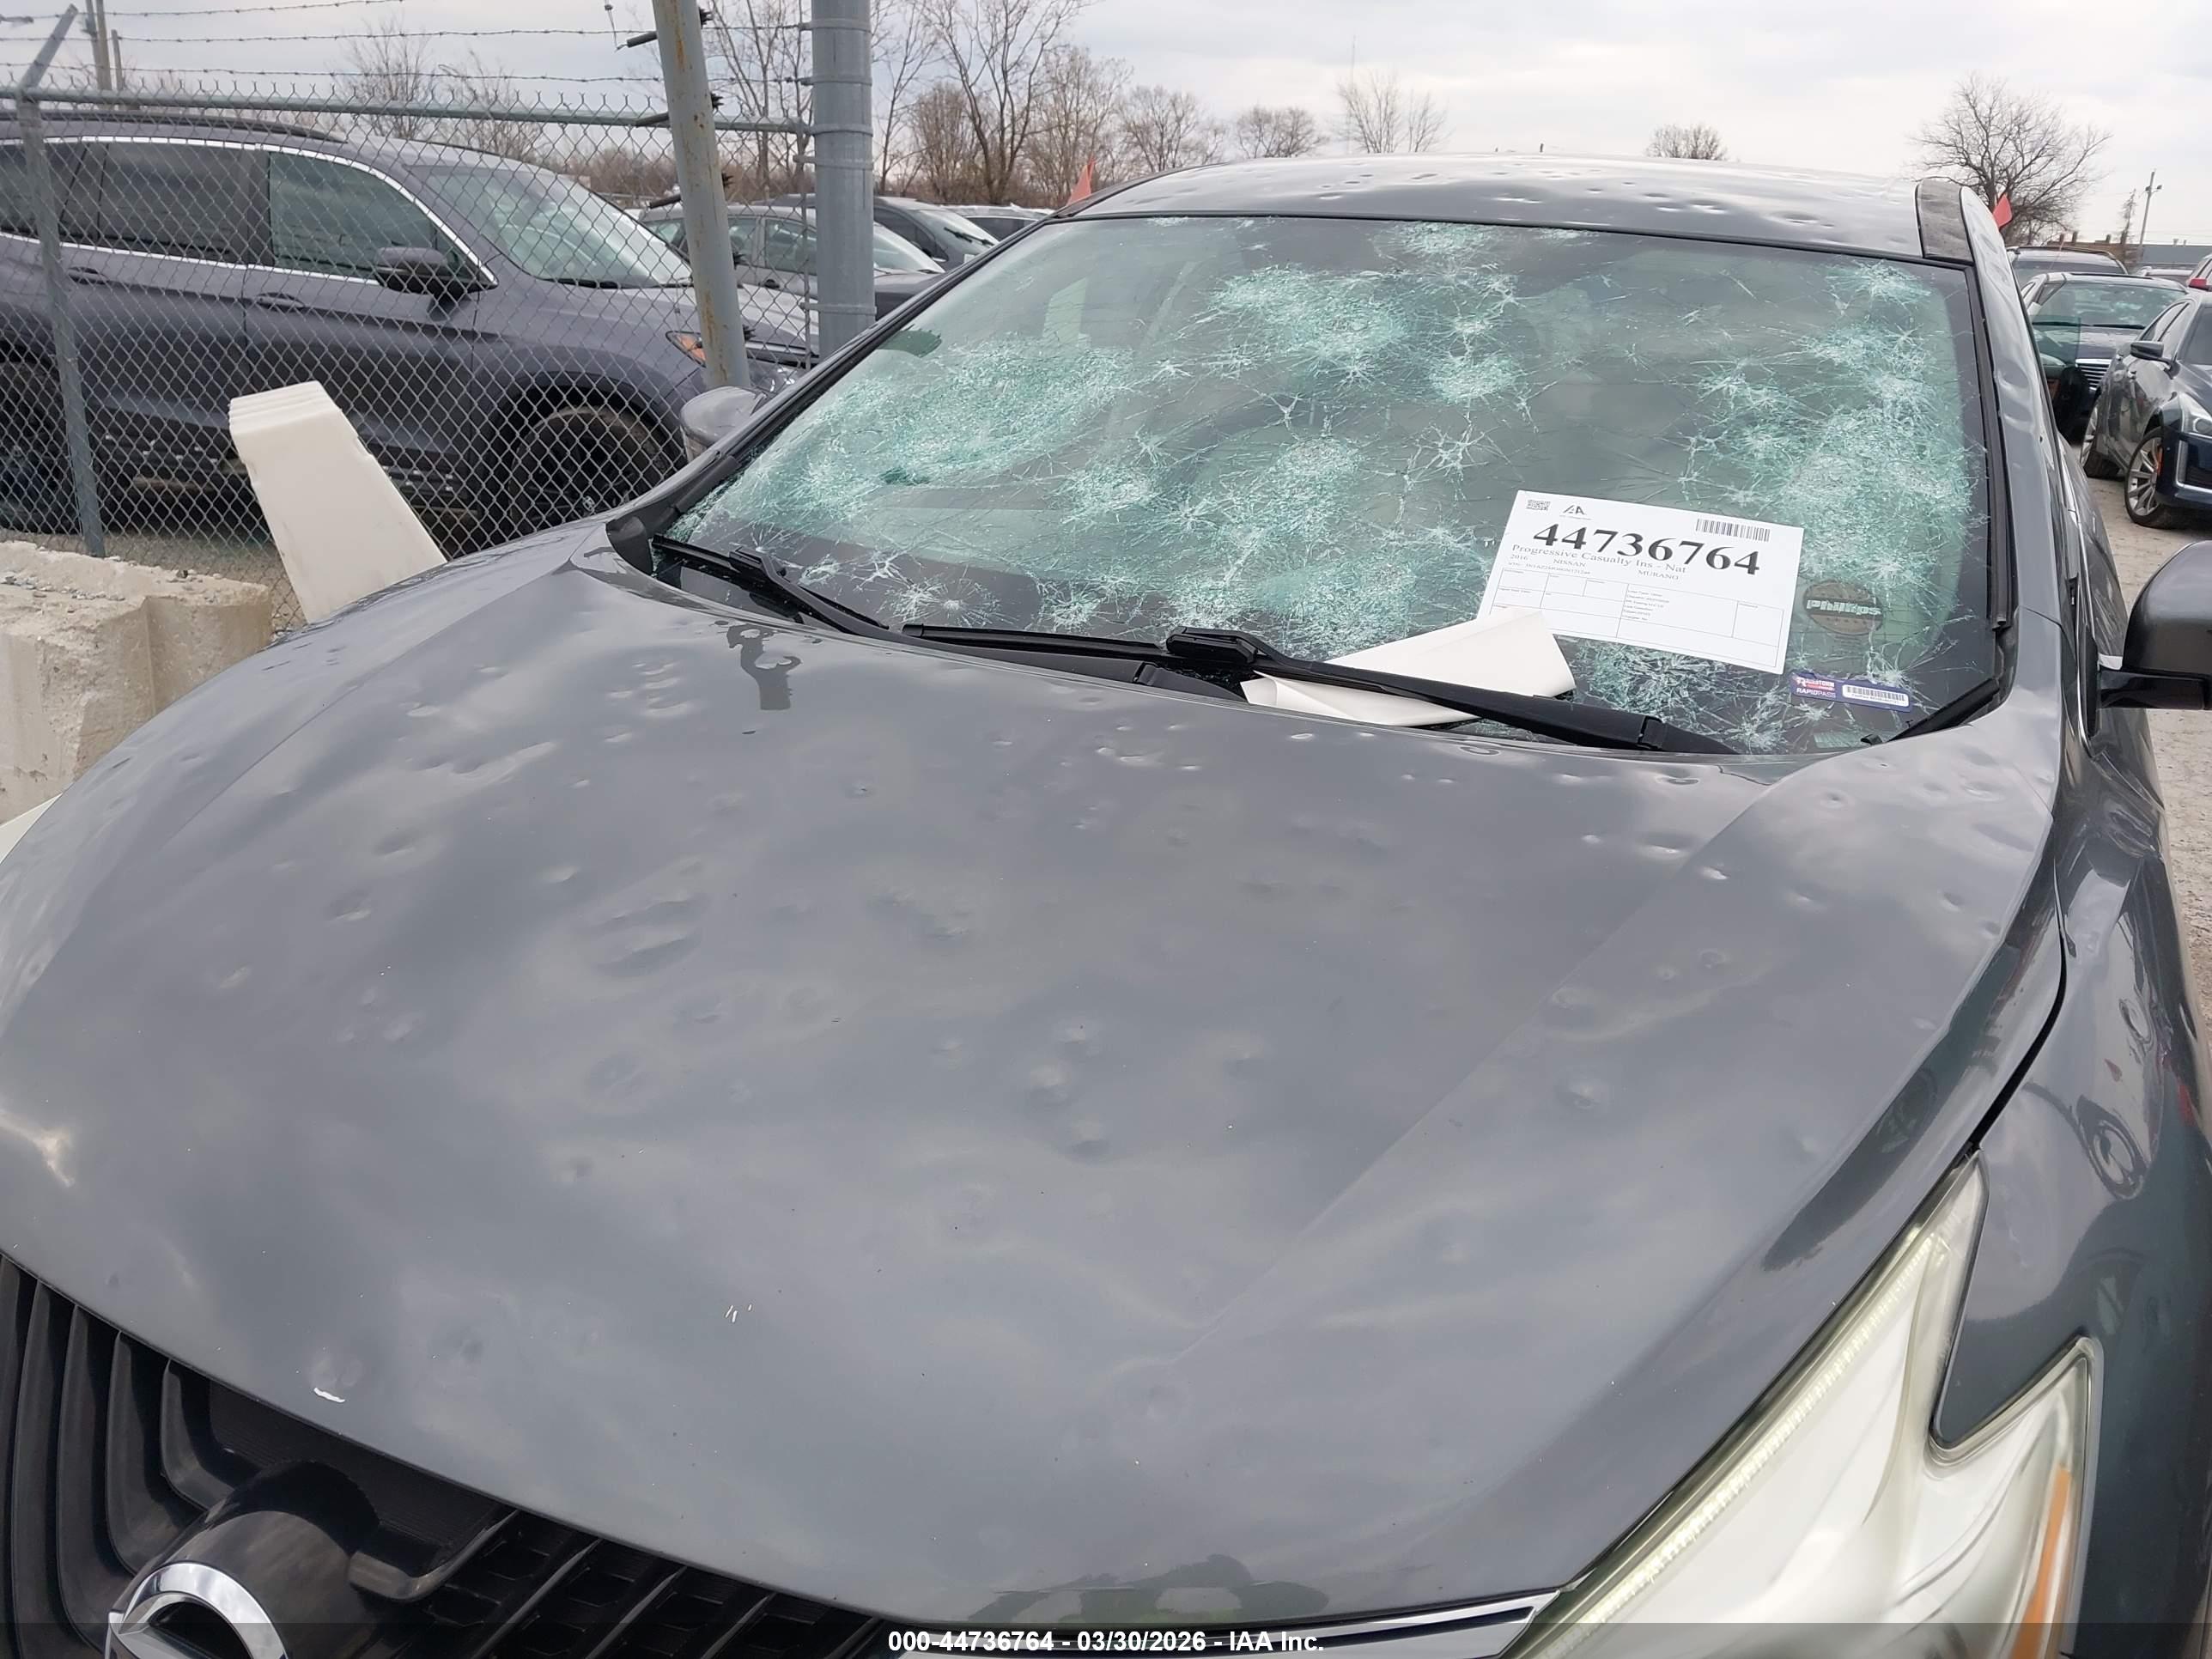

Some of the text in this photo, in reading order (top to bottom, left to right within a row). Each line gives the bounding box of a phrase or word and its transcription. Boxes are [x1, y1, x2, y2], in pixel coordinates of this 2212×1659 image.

[1512, 544, 1578, 557] Progressive
[1581, 552, 1633, 567] Casualty
[1636, 559, 1653, 568] Ins
[1665, 563, 1686, 574] Nat
[1533, 523, 1759, 575] 44736764
[1553, 558, 1587, 568] NISSAN
[1637, 569, 1680, 580] MURANO
